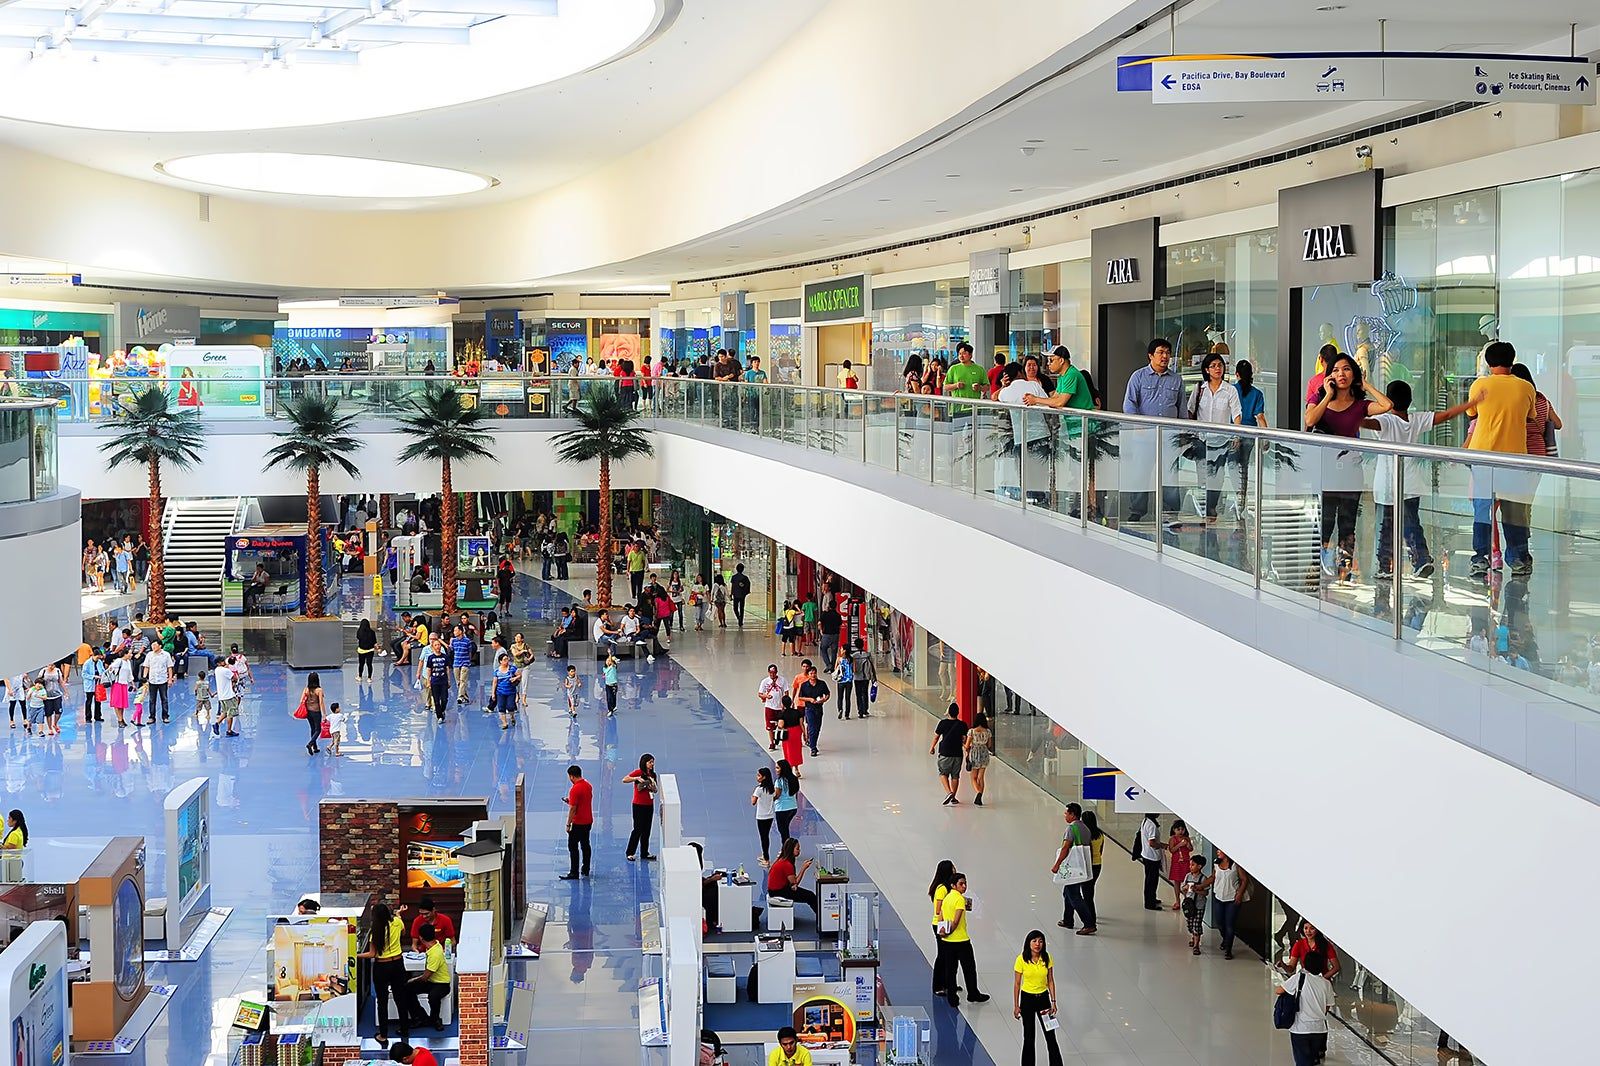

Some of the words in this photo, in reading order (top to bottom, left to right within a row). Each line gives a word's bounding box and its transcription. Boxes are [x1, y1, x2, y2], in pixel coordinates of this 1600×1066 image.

[1182, 72, 1211, 80] Pacifica
[1213, 72, 1233, 80] Drive,
[1235, 72, 1249, 80] Bay
[1250, 71, 1286, 79] Boulevard
[1520, 72, 1545, 81] Skating
[1182, 83, 1201, 91] EDSA
[1508, 82, 1543, 91] Foodcourt,
[1544, 83, 1571, 91] Cinemas
[1302, 225, 1347, 261] ZARA
[1106, 258, 1134, 285] ZARA
[833, 286, 860, 310] SPENCER
[202, 352, 227, 362] Green
[43, 887, 65, 895] Shell
